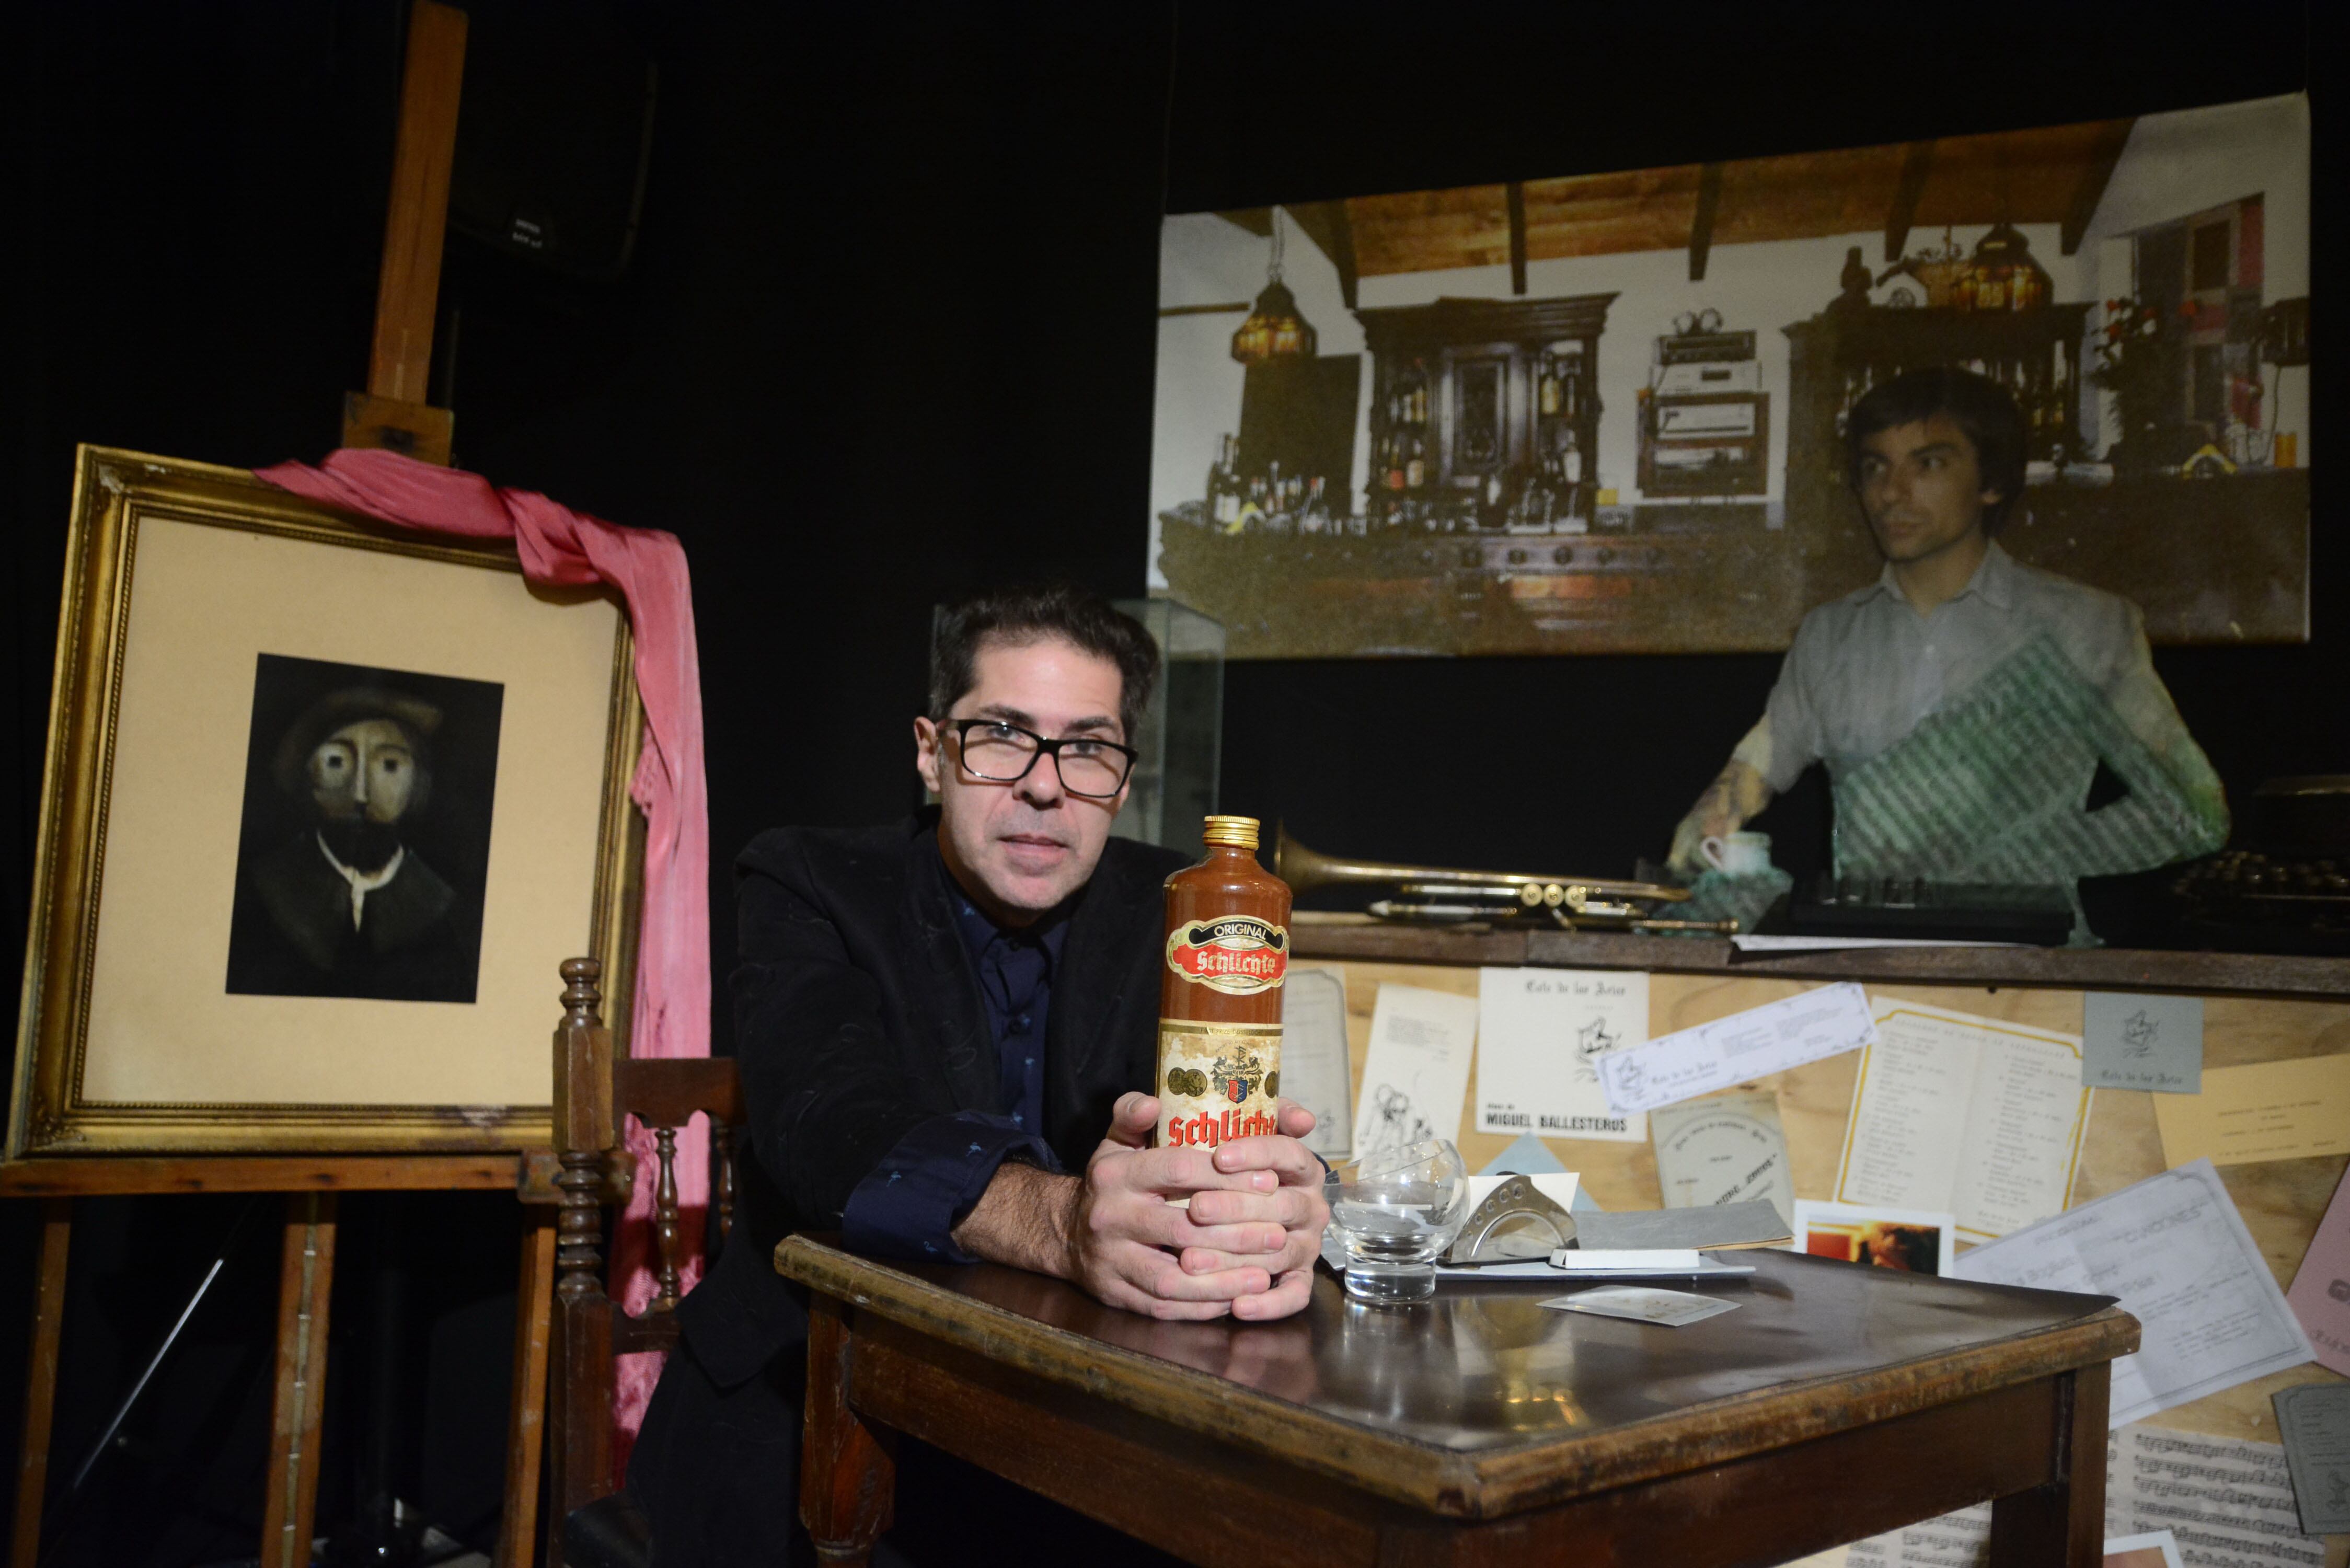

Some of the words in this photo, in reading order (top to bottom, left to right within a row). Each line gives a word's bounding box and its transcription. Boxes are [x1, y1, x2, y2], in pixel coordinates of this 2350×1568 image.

[1214, 924, 1266, 940] ORIGINAL
[1196, 951, 1276, 975] Schlichte
[1486, 1113, 1533, 1127] MIGUEL
[1539, 1115, 1628, 1132] BALLESTEROS
